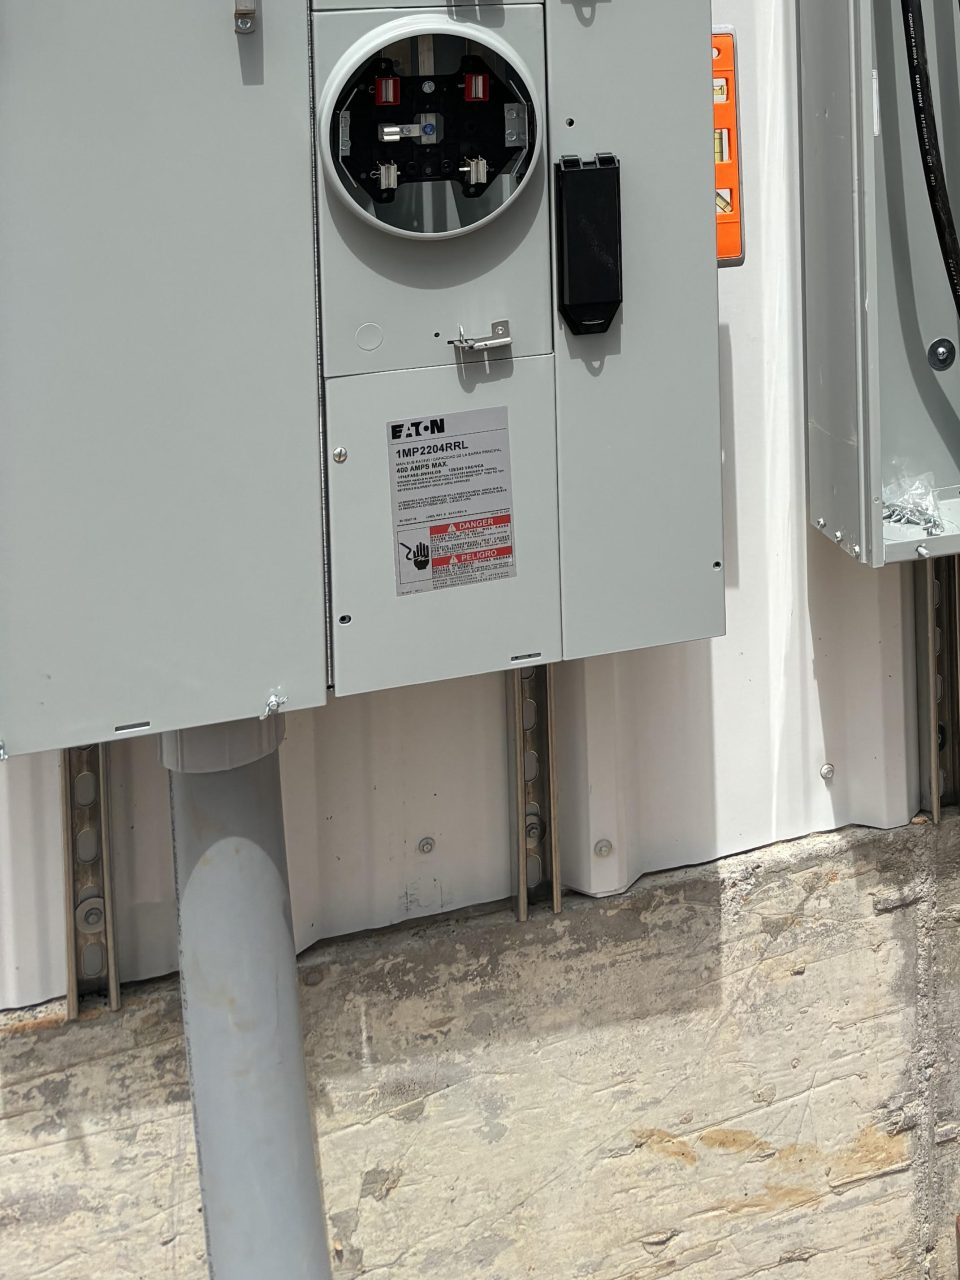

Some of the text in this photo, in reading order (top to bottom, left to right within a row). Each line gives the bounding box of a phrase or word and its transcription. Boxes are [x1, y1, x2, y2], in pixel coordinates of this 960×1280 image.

[391, 418, 445, 439] EATON
[396, 440, 468, 458] 1MP2204RRL
[409, 463, 429, 471] AMPS
[459, 517, 493, 529] DANGER
[461, 549, 497, 561] PELIGRO
